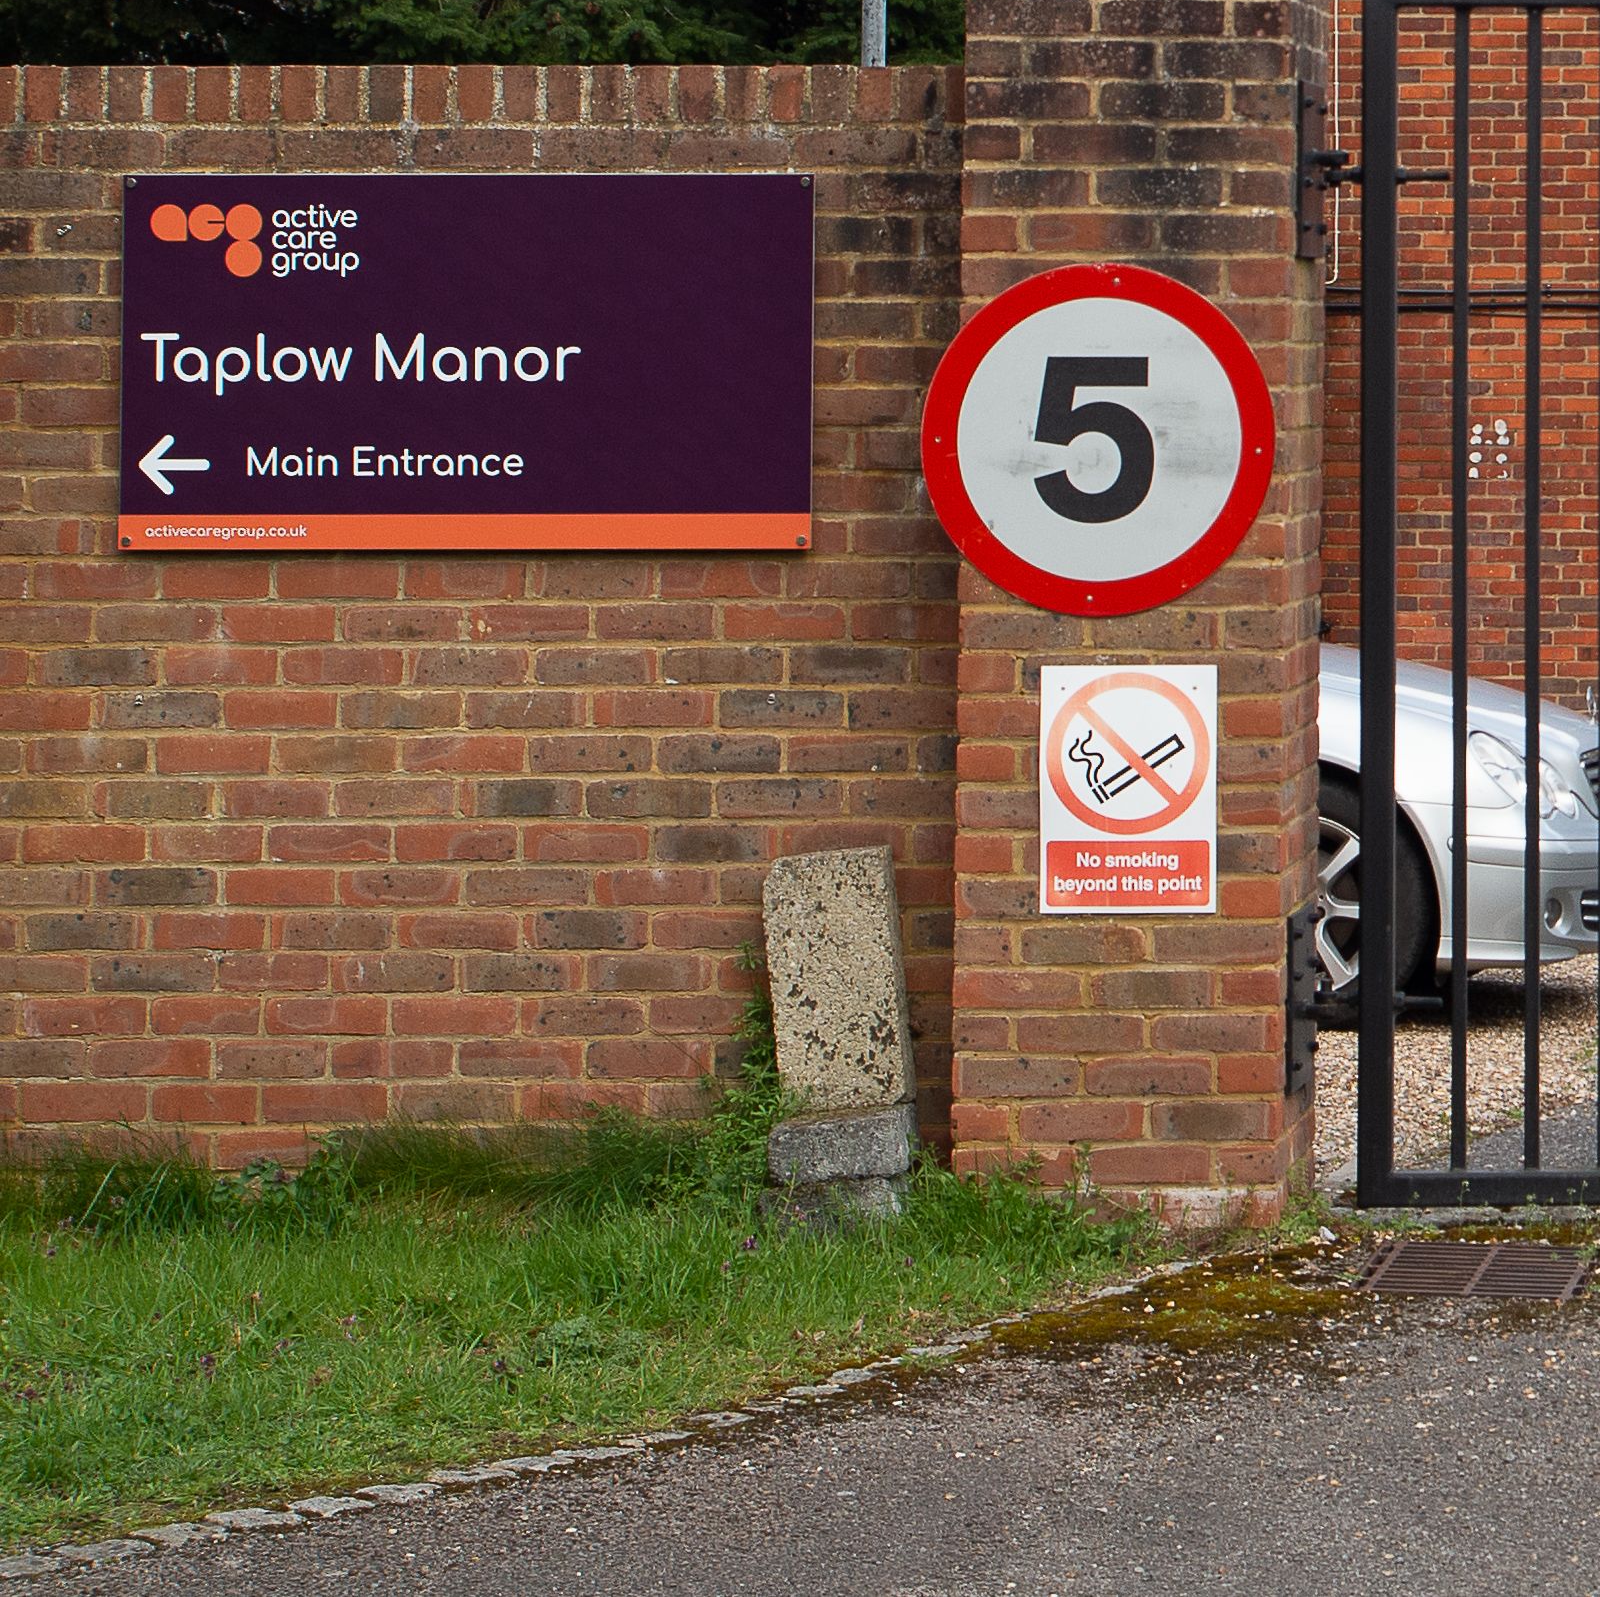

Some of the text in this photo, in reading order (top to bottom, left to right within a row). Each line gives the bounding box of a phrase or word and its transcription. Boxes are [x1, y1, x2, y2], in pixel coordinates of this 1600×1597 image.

[272, 203, 358, 229] active
[272, 231, 337, 250] care
[272, 251, 360, 278] group
[140, 332, 582, 396] Taplow Manor
[1034, 356, 1155, 524] 5
[246, 445, 525, 477] Main Entrance
[145, 523, 308, 541] activecaregroup.co.uk
[1076, 851, 1179, 872] No smoking
[1053, 875, 1203, 896] beyond this point
